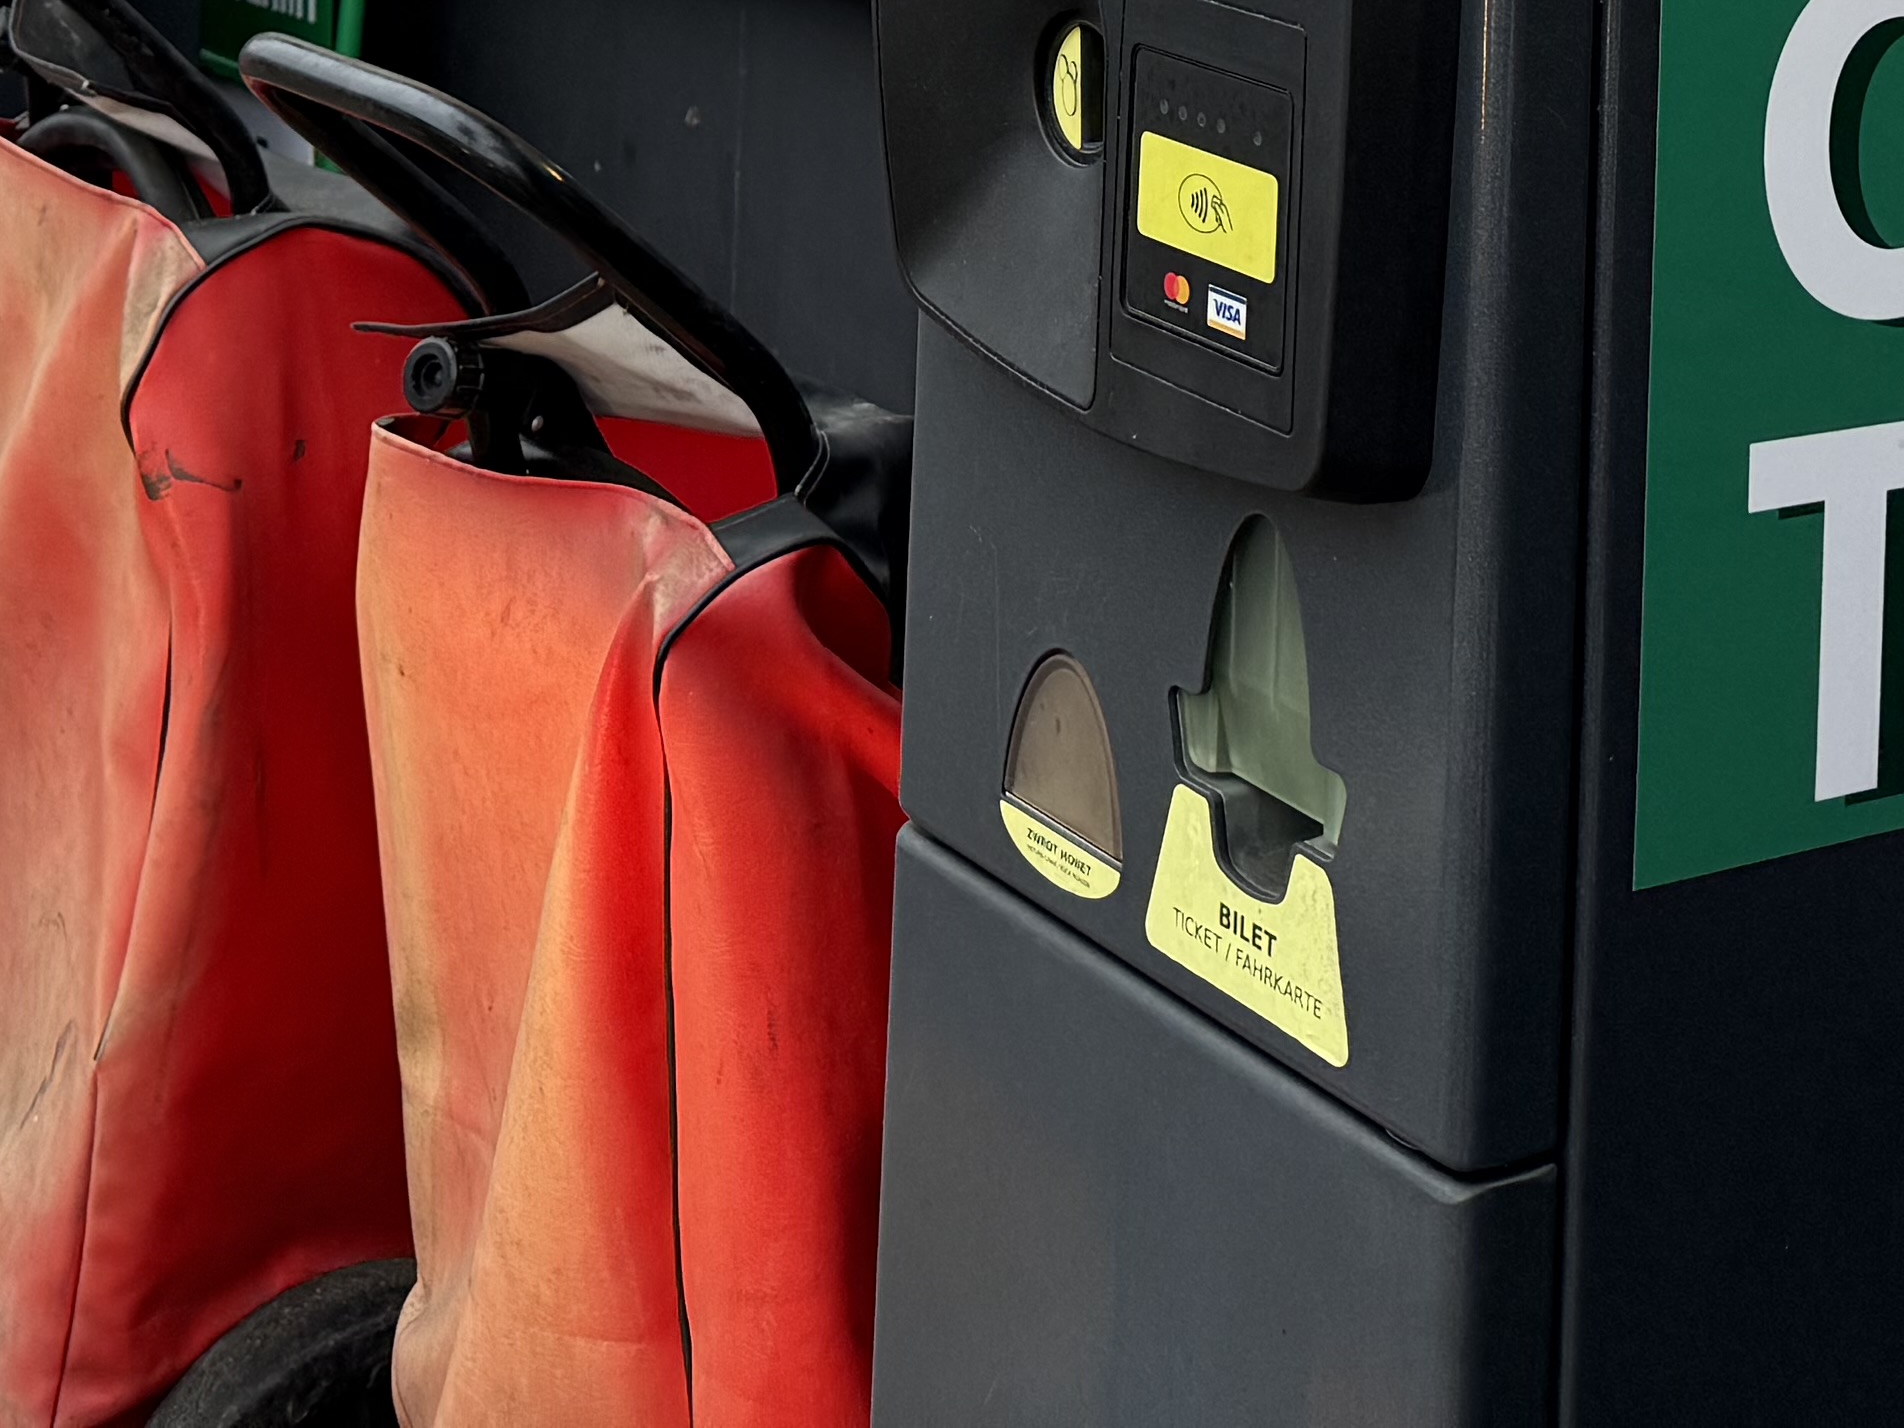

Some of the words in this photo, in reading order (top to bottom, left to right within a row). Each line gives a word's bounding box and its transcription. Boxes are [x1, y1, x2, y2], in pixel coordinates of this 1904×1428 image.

[1213, 298, 1242, 326] VISA
[1219, 901, 1277, 957] BILET
[1172, 906, 1223, 953] TICKET
[1236, 947, 1324, 1020] FAHRKARTE
